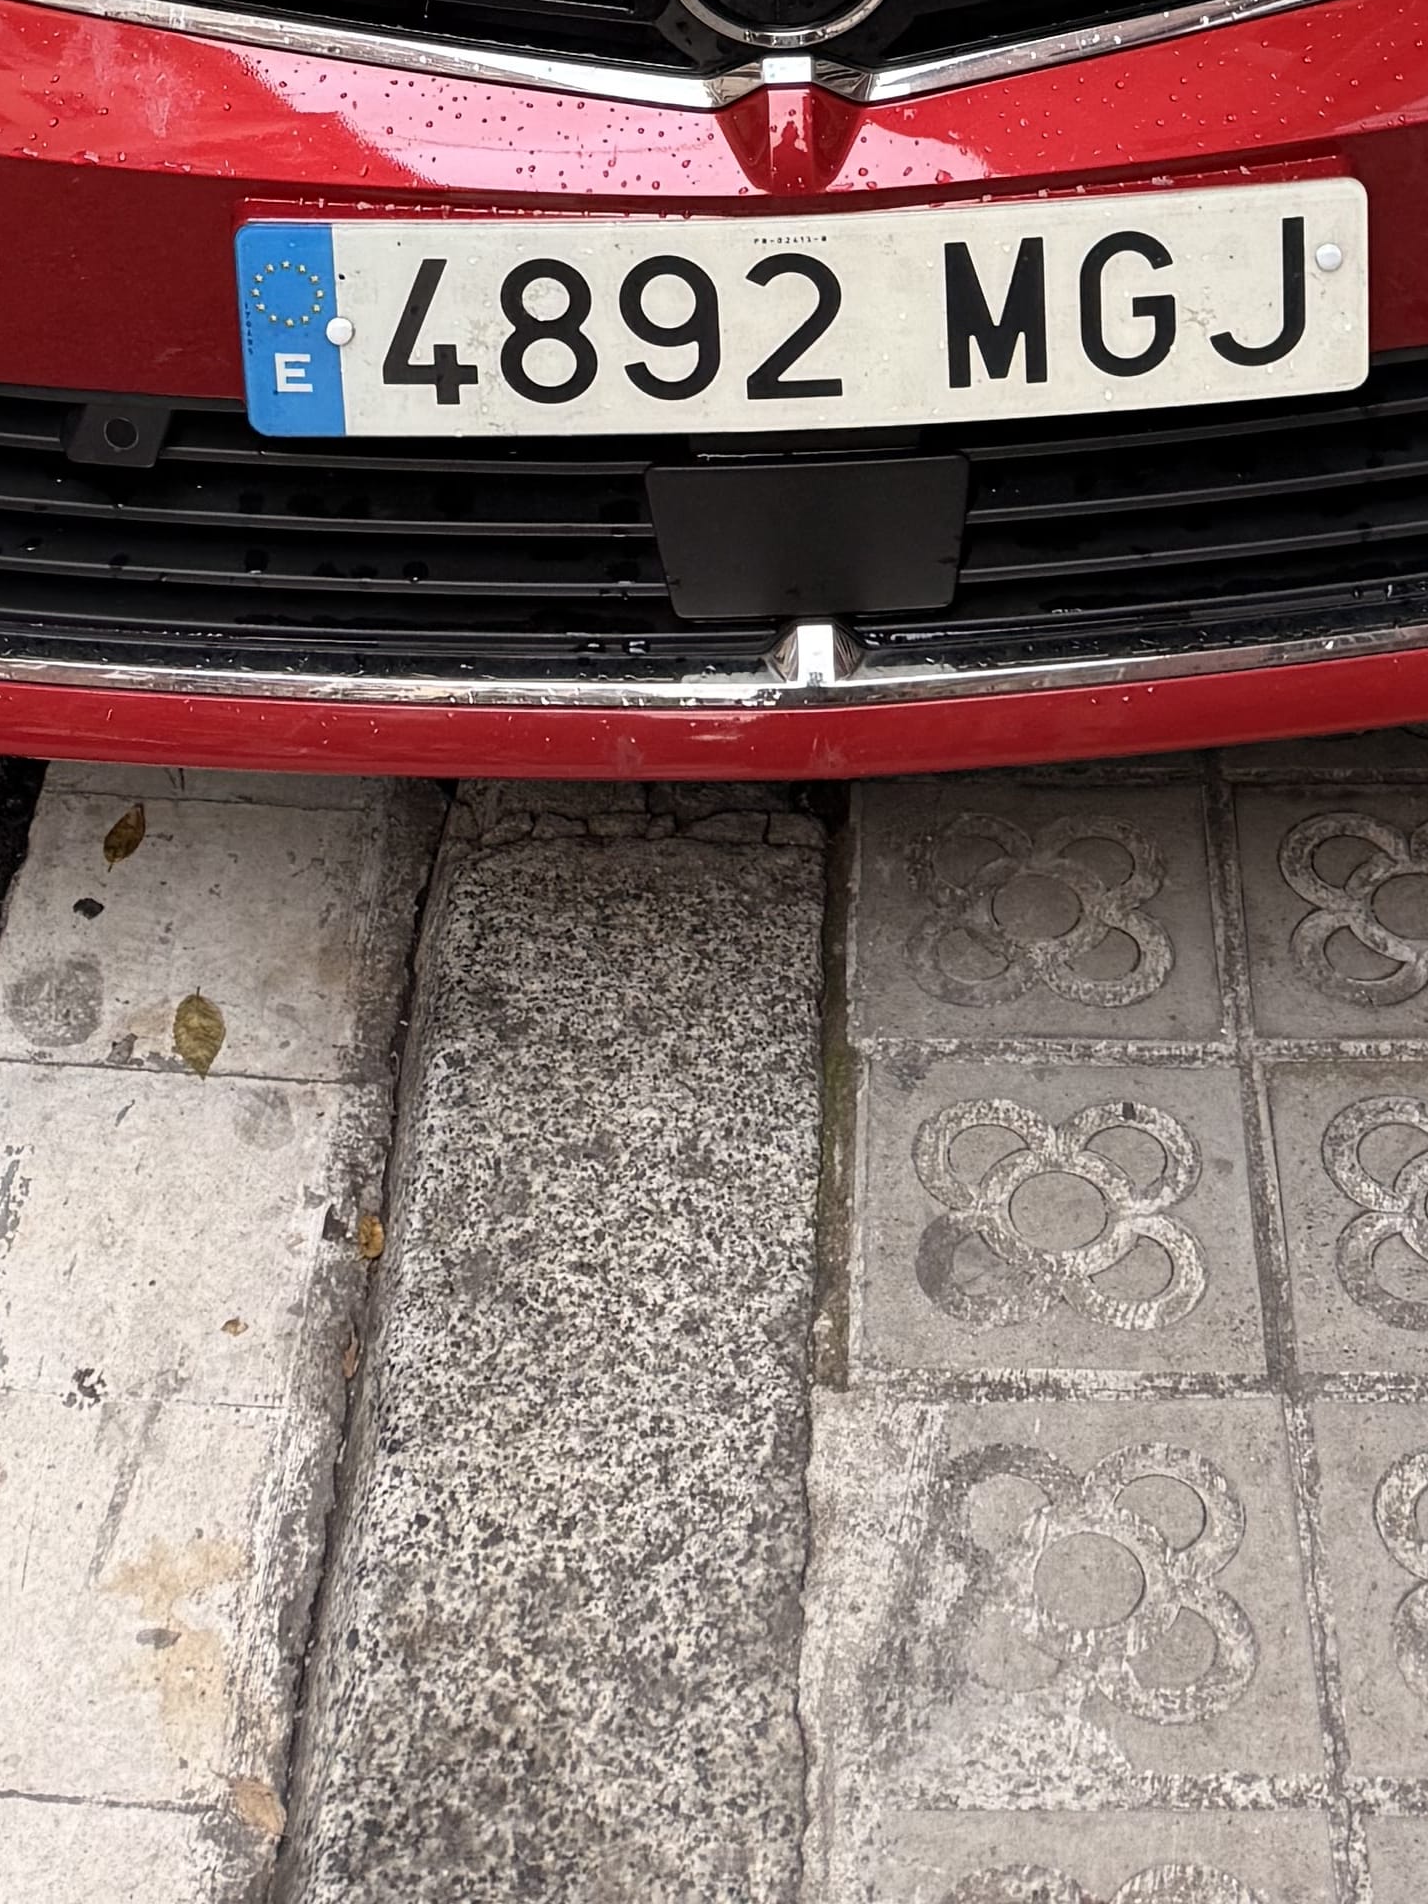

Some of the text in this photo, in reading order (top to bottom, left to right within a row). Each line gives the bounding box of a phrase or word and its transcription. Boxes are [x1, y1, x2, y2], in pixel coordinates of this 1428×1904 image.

[381, 216, 1306, 406] 4892 MGJ
[274, 352, 314, 393] E
